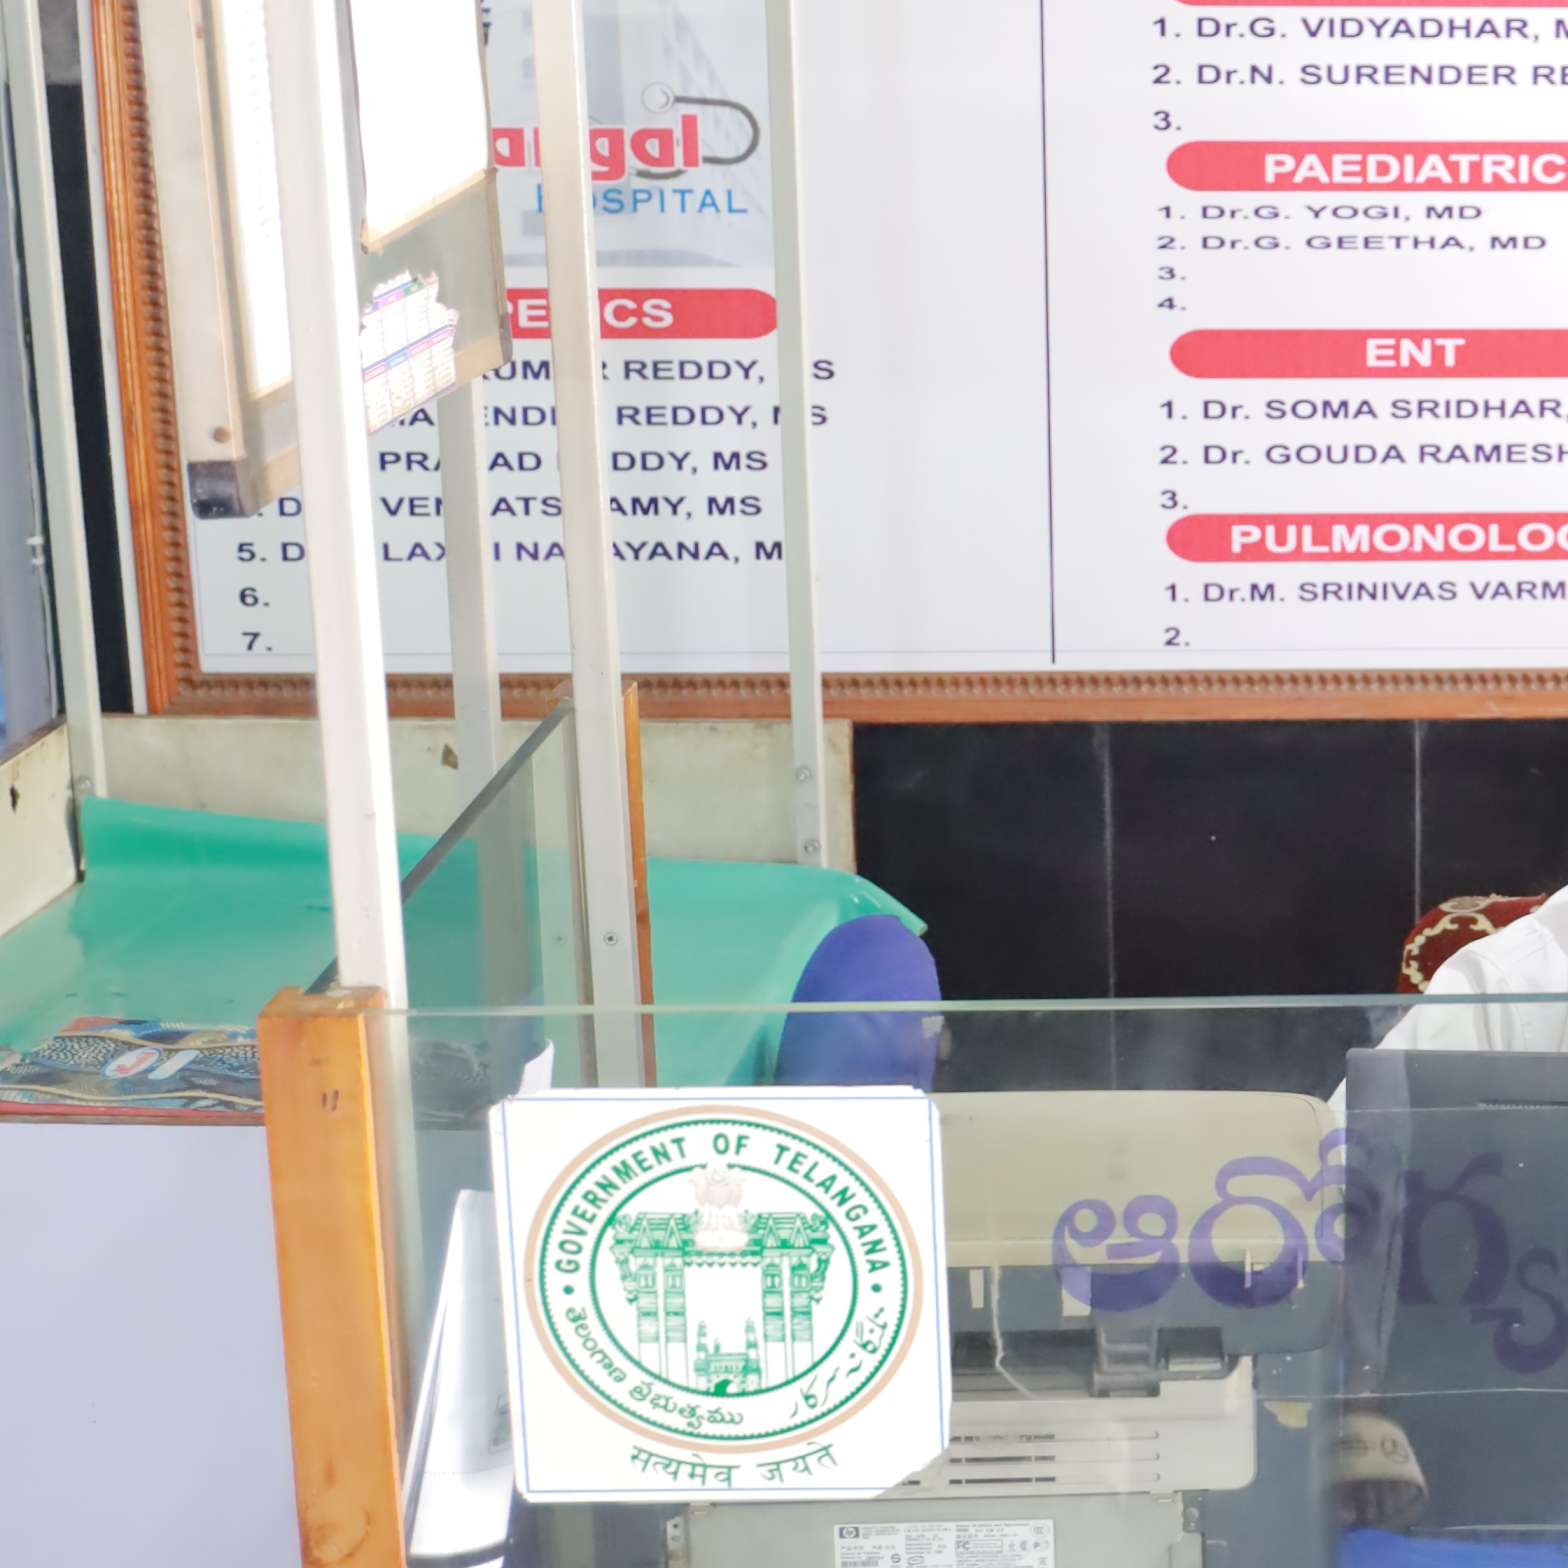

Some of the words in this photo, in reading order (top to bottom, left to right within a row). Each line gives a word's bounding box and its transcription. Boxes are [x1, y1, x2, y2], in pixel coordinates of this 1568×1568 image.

[1154, 17, 1180, 37] 1.
[1197, 17, 1285, 38] Dr.G.
[1302, 18, 1538, 40] VIDYADHAR,
[1153, 64, 1180, 84] 2.
[1198, 64, 1283, 84] Dr.N.
[1300, 64, 1516, 85] SURENDER
[1154, 111, 1181, 131] 3.
[1159, 205, 1184, 219] 1.
[1202, 205, 1288, 219] Dr.G.
[1306, 206, 1409, 221] YOGI,
[1426, 206, 1482, 219] MD
[1157, 236, 1185, 250] 2.
[1202, 236, 1288, 249] Dr.G.
[1306, 236, 1474, 251] GEETHA,
[1491, 236, 1546, 249] MD
[1158, 267, 1184, 280] 3.
[1158, 297, 1185, 310] 4.
[1366, 338, 1465, 367] ENT
[624, 360, 764, 383] REDDY,
[617, 406, 757, 428] REDDY,
[1161, 400, 1186, 419] 1.
[1204, 400, 1248, 419] Dr.
[1266, 400, 1377, 419] SOMA
[713, 451, 768, 470] MS
[1160, 445, 1187, 464] 2.
[1204, 445, 1249, 464] Dr.
[1266, 445, 1405, 464] GOUDA
[708, 496, 761, 515] MS
[1161, 490, 1187, 509] 3.
[238, 543, 266, 562] 5.
[240, 587, 269, 606] 6.
[1166, 584, 1188, 602] 1.
[1204, 583, 1284, 602] Dr.M.
[1299, 582, 1456, 601] SRINIVAS
[242, 632, 272, 651] 7.
[1165, 627, 1189, 646] 2.
[555, 1136, 687, 1276] GOVERNMENT
[712, 1132, 751, 1156] OF
[775, 1143, 891, 1275] TELANGANA
[565, 1304, 628, 1386] తెలంగాణ
[630, 1377, 744, 1430] ప్రభుత్వము
[630, 1444, 740, 1489] सत्यमेव
[756, 1440, 839, 1484] जयते
